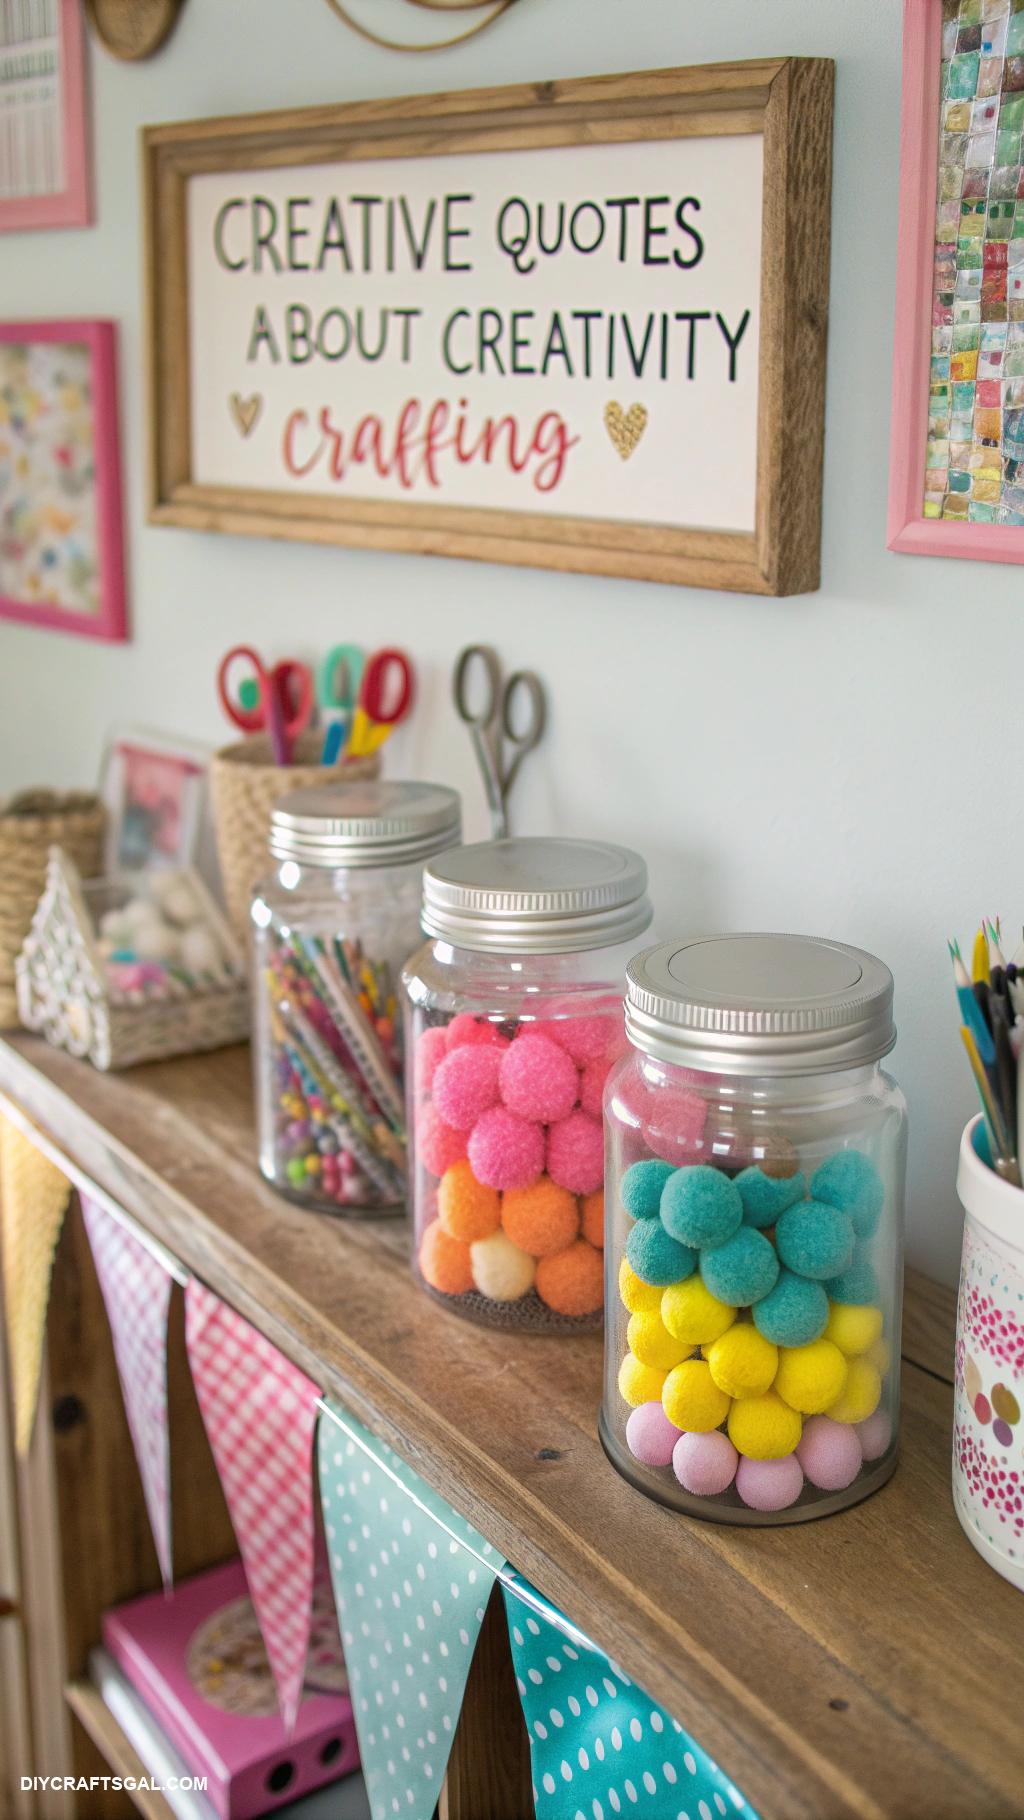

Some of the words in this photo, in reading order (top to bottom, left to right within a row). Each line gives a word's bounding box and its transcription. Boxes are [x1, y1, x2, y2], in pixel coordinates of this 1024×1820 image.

[213, 194, 474, 274] CREATIVE
[497, 195, 705, 275] QUOTES
[247, 303, 422, 365] ABOUT
[442, 308, 751, 382] CREATIVITY
